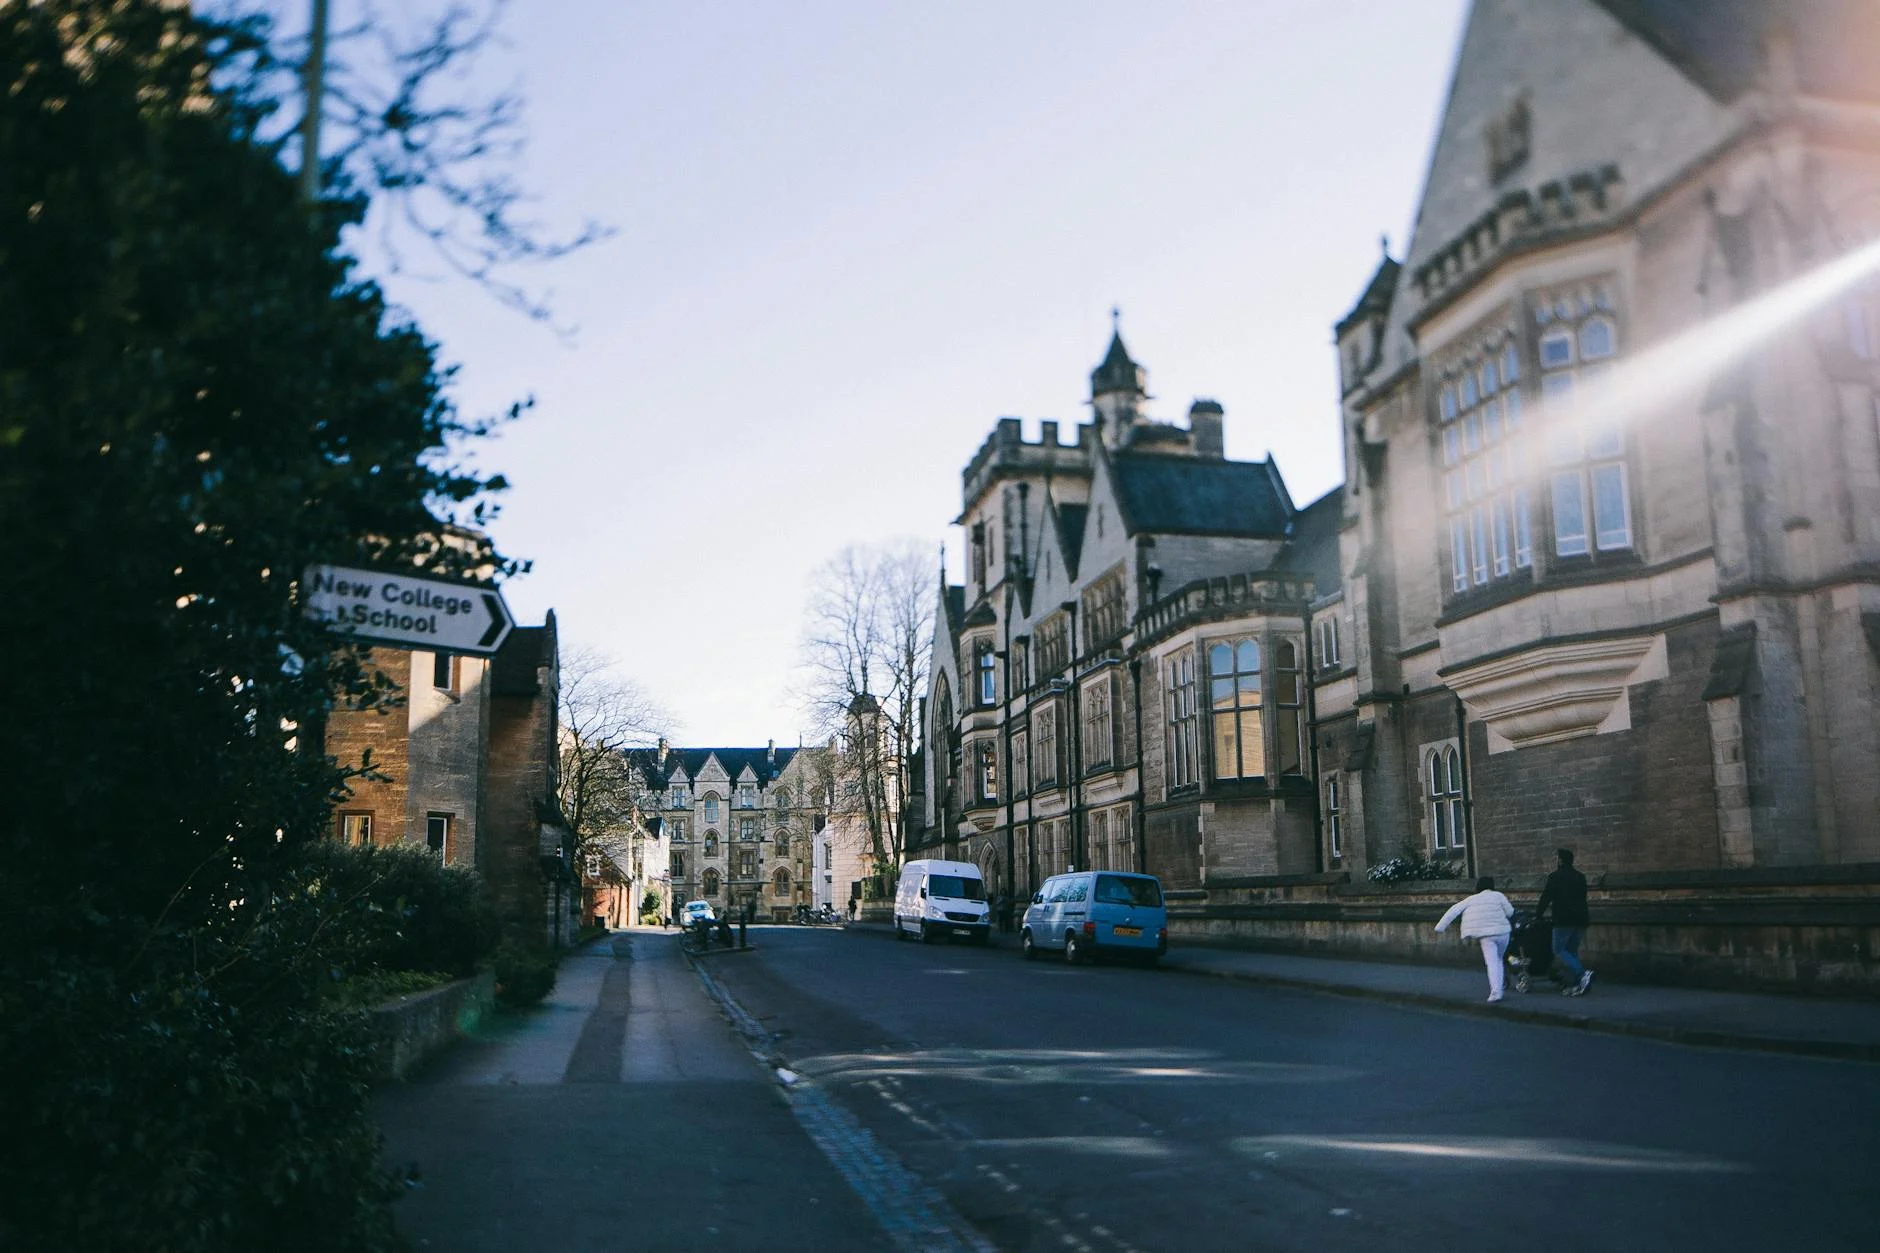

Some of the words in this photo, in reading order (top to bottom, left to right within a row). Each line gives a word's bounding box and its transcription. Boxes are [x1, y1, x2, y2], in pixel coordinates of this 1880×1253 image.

[313, 572, 373, 599] New
[381, 582, 473, 615] College
[352, 604, 437, 634] School
